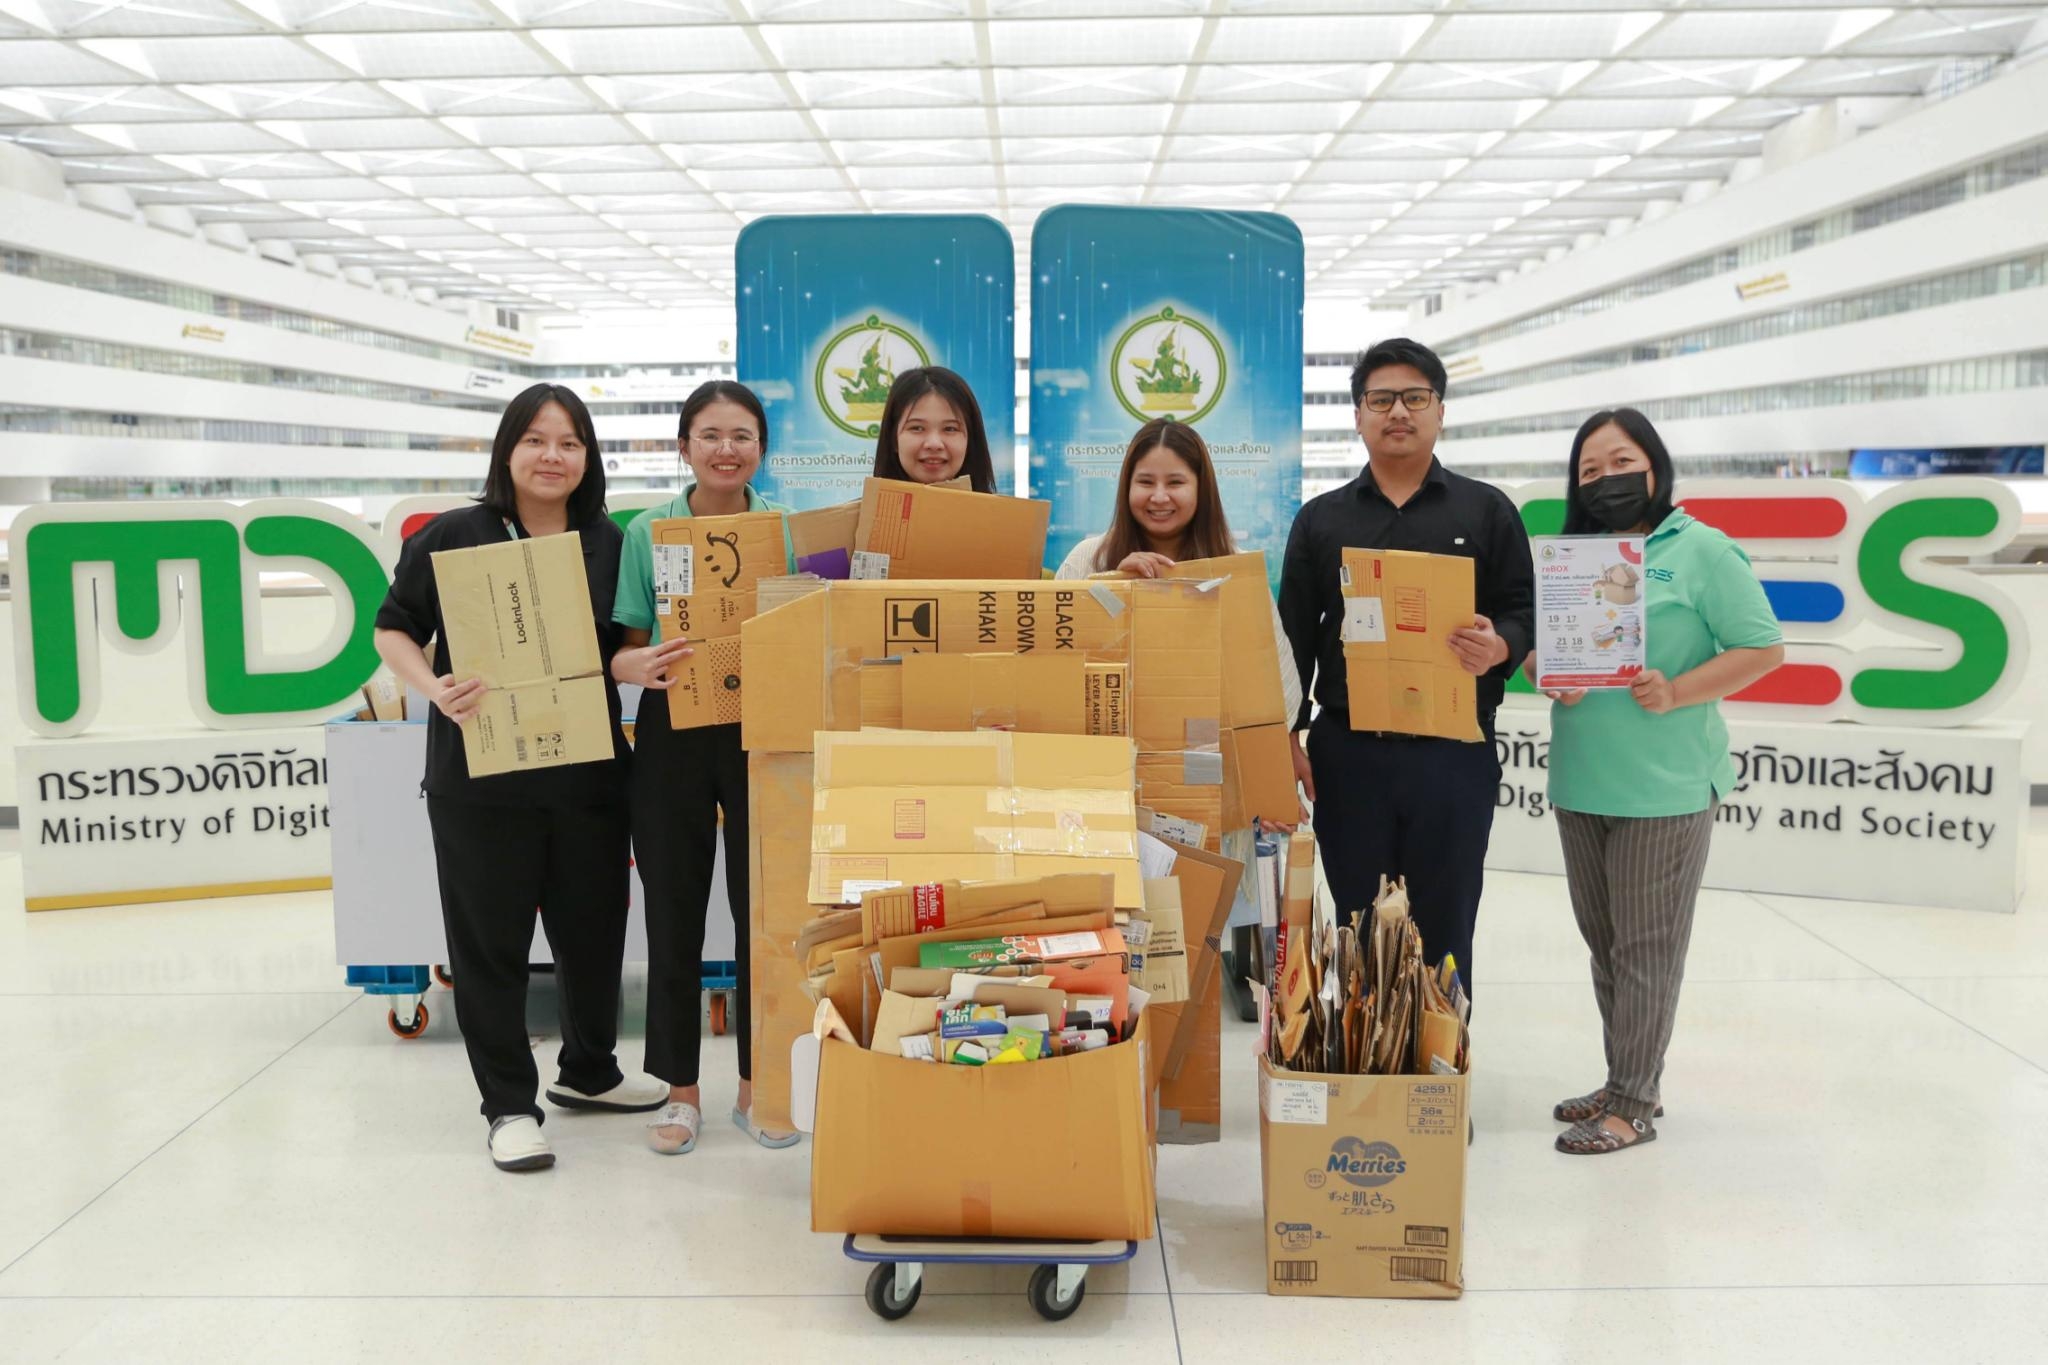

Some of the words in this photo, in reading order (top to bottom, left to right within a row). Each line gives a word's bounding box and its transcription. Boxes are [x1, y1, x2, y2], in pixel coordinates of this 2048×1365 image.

[507, 580, 528, 645] LocknLock
[728, 601, 736, 616] YOU
[978, 591, 996, 643] KHAKI
[1055, 591, 1073, 650] BLACK
[1548, 615, 1560, 623] 19
[1567, 615, 1577, 623] 17
[1556, 637, 1567, 645] 21
[1572, 637, 1583, 645] 18
[1092, 674, 1100, 699] LEVER
[1092, 702, 1100, 725] ARCH
[1109, 690, 1120, 735] Elephant
[40, 815, 186, 844] Ministry
[203, 808, 235, 835] of
[1779, 805, 1842, 832] and
[1861, 806, 1996, 849] Society
[1414, 1085, 1451, 1094] 42591
[1326, 1154, 1407, 1174] Merries
